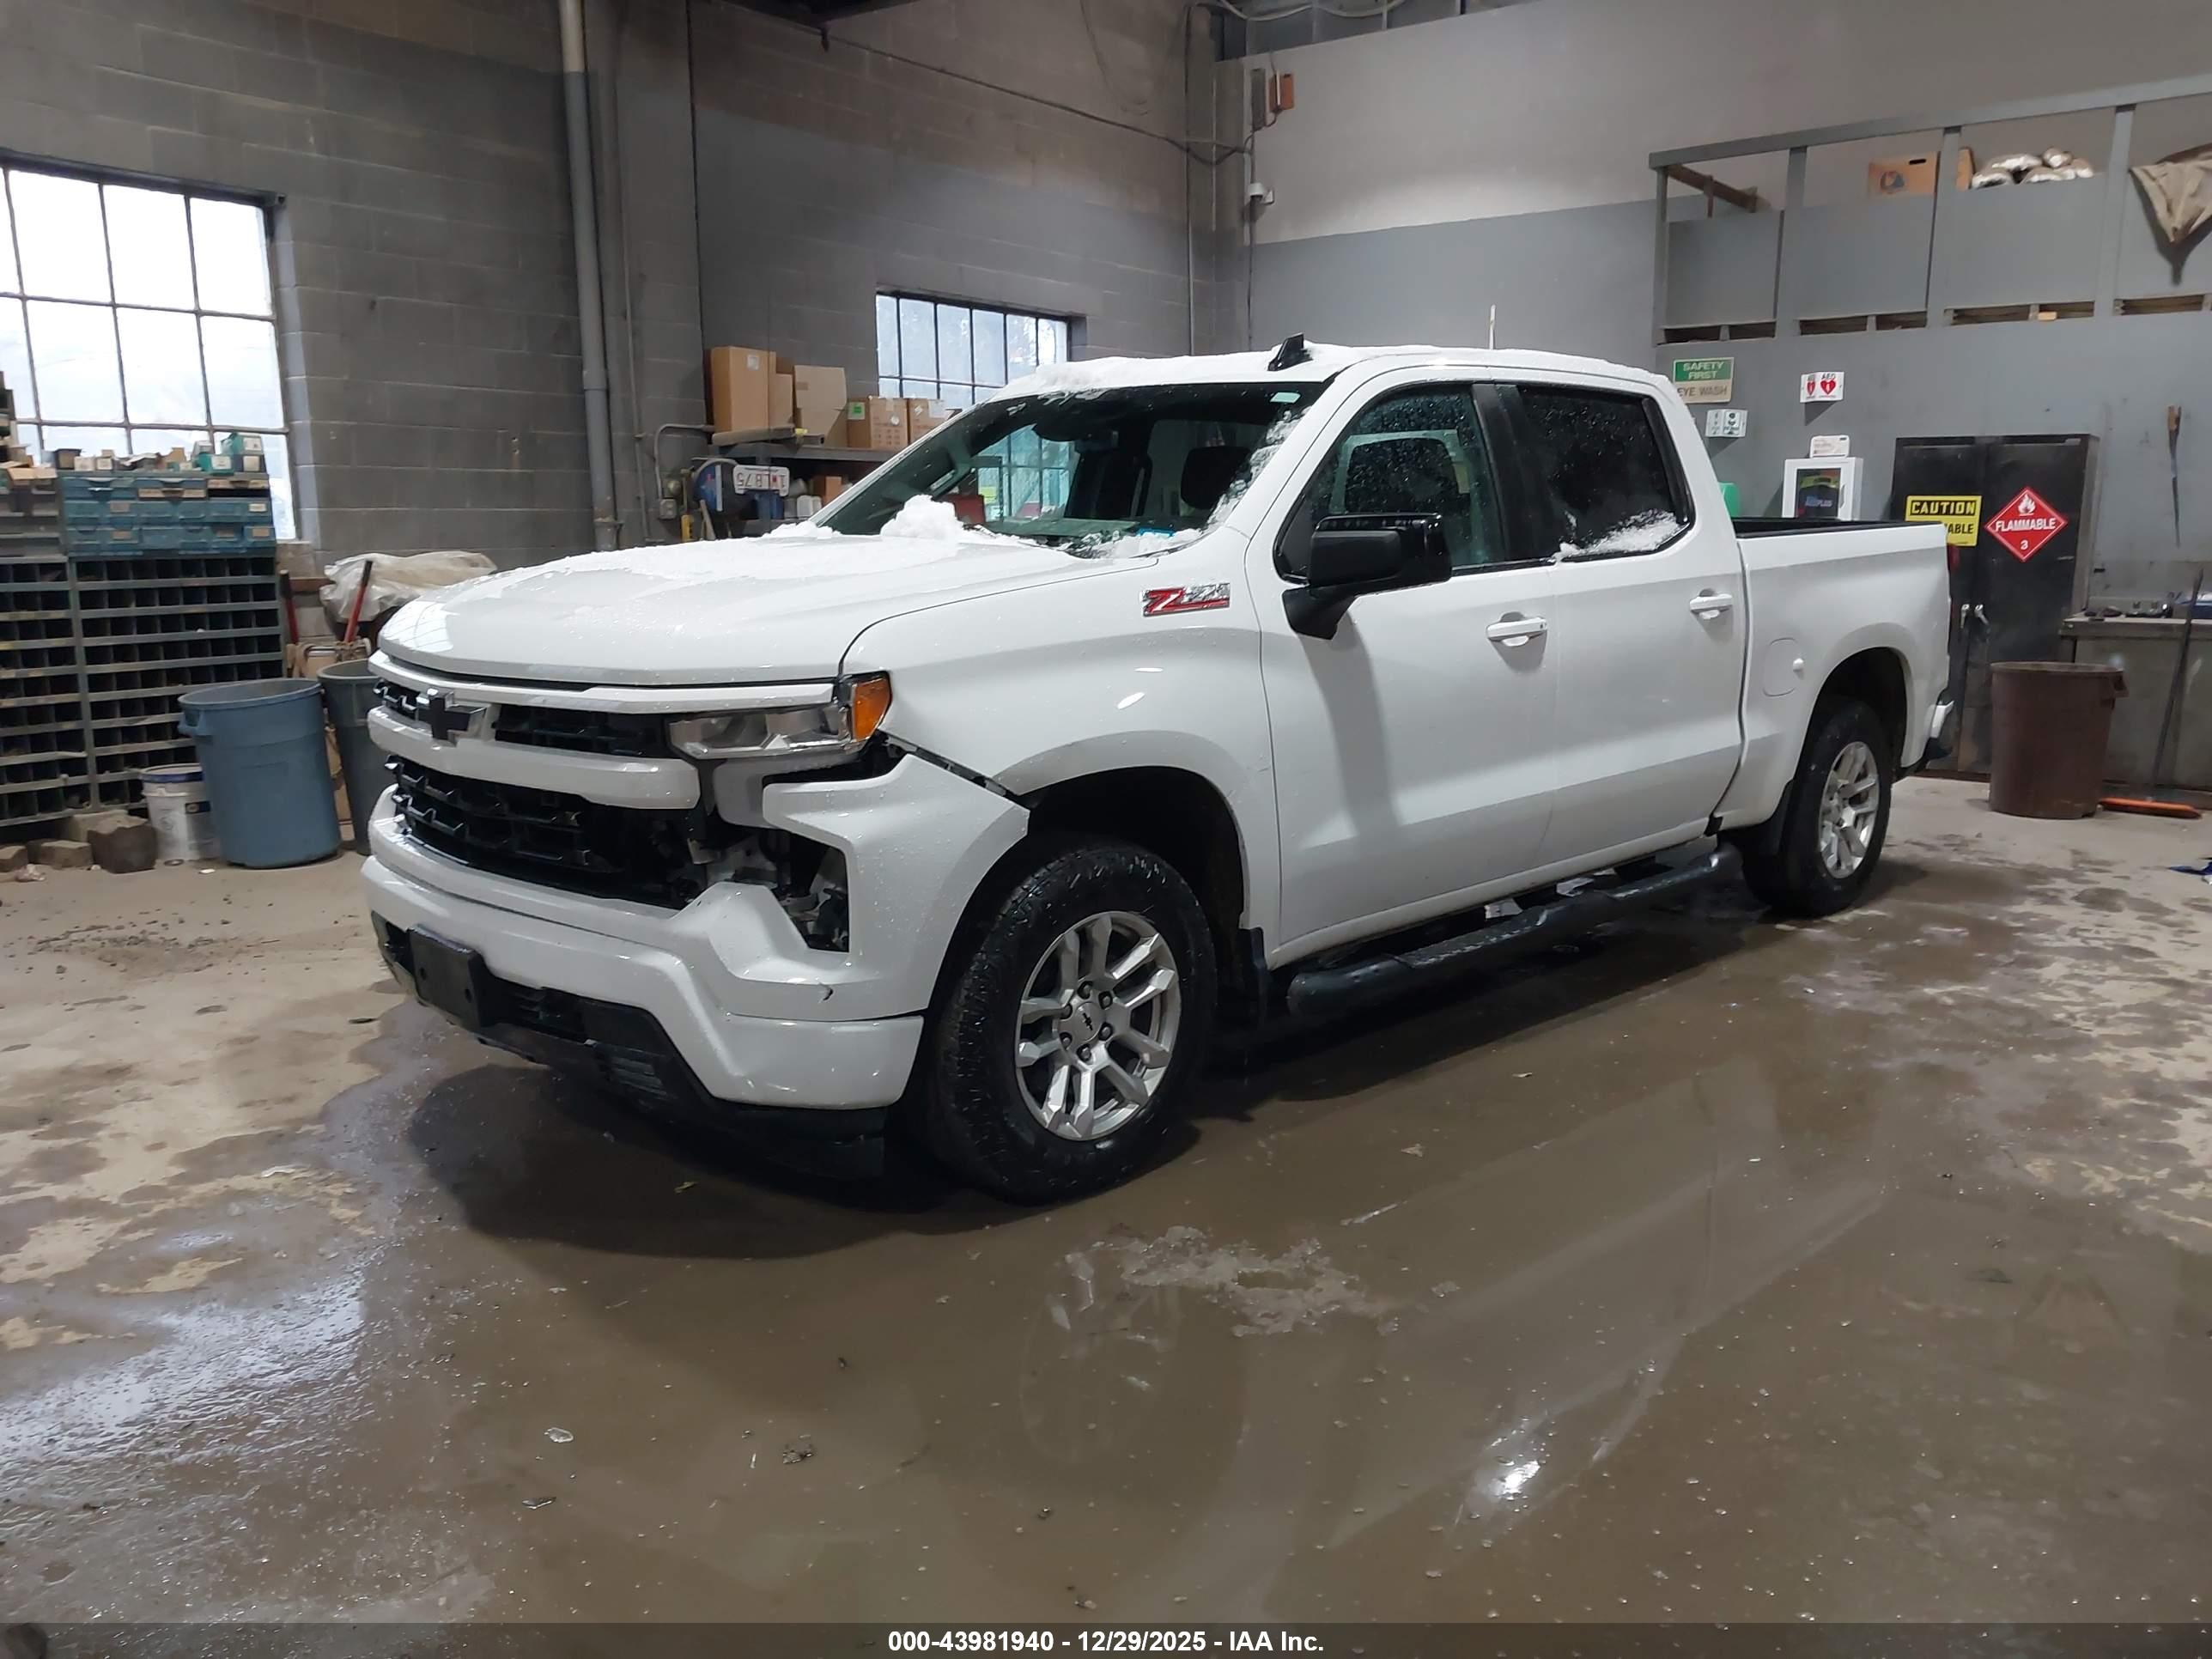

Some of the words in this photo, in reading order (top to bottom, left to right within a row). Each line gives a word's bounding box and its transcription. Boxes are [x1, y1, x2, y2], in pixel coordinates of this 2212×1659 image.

[1683, 362, 1724, 372] SAFETY
[1688, 370, 1717, 380] FIRST
[1698, 385, 1728, 396] WASH
[1911, 501, 1975, 515] CAUTION
[1995, 517, 2057, 532] FLAMMABLE
[2020, 540, 2029, 550] 3
